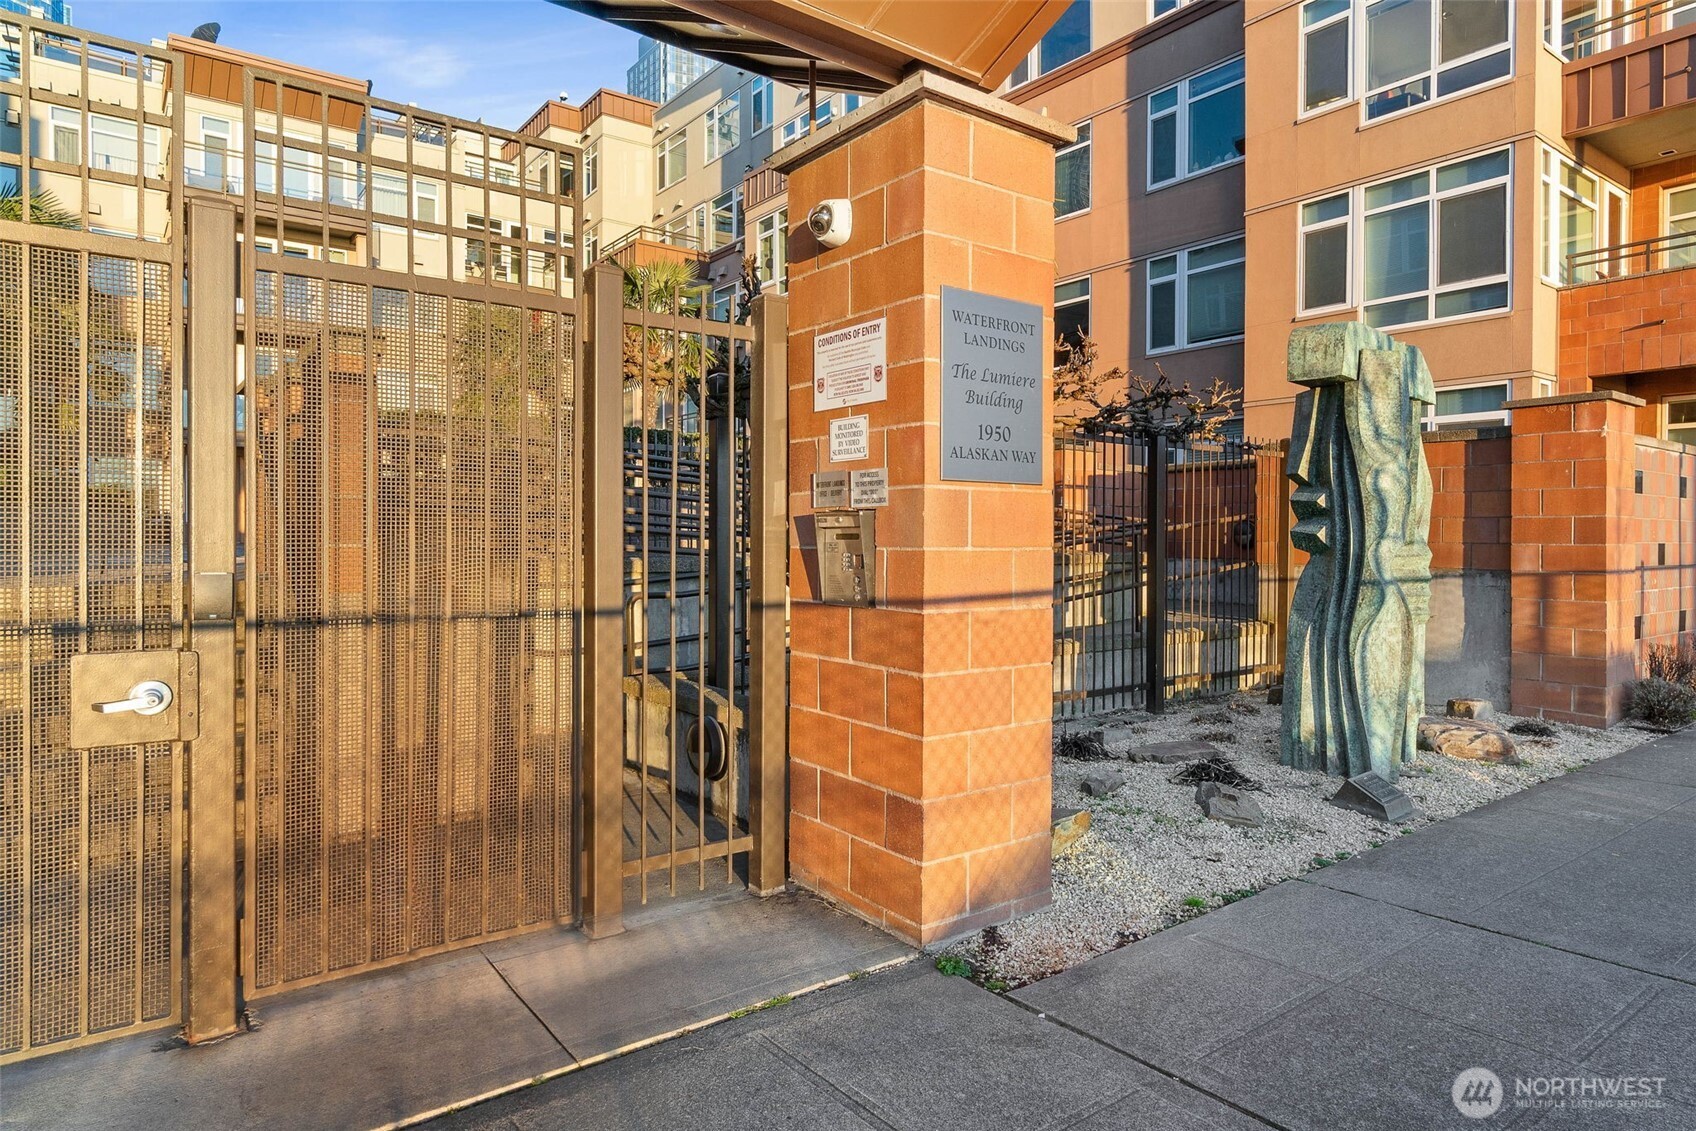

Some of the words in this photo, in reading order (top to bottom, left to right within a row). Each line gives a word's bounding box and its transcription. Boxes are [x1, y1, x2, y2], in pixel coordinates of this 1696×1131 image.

[952, 309, 1036, 336] WATERFRONT
[818, 331, 852, 348] CONDITIONS
[852, 328, 860, 338] OF
[862, 322, 881, 336] ENTRY
[964, 332, 1026, 354] LANDINGS
[952, 362, 977, 380] The
[980, 368, 1036, 388] Lumiere
[965, 389, 1024, 414] Building
[834, 430, 863, 439] MONITORED
[838, 422, 860, 431] BUILDING
[978, 424, 1011, 443] 1950
[832, 446, 865, 456] SURVEILLANCE
[950, 446, 1008, 462] ALASKAN
[1012, 450, 1036, 464] WAY
